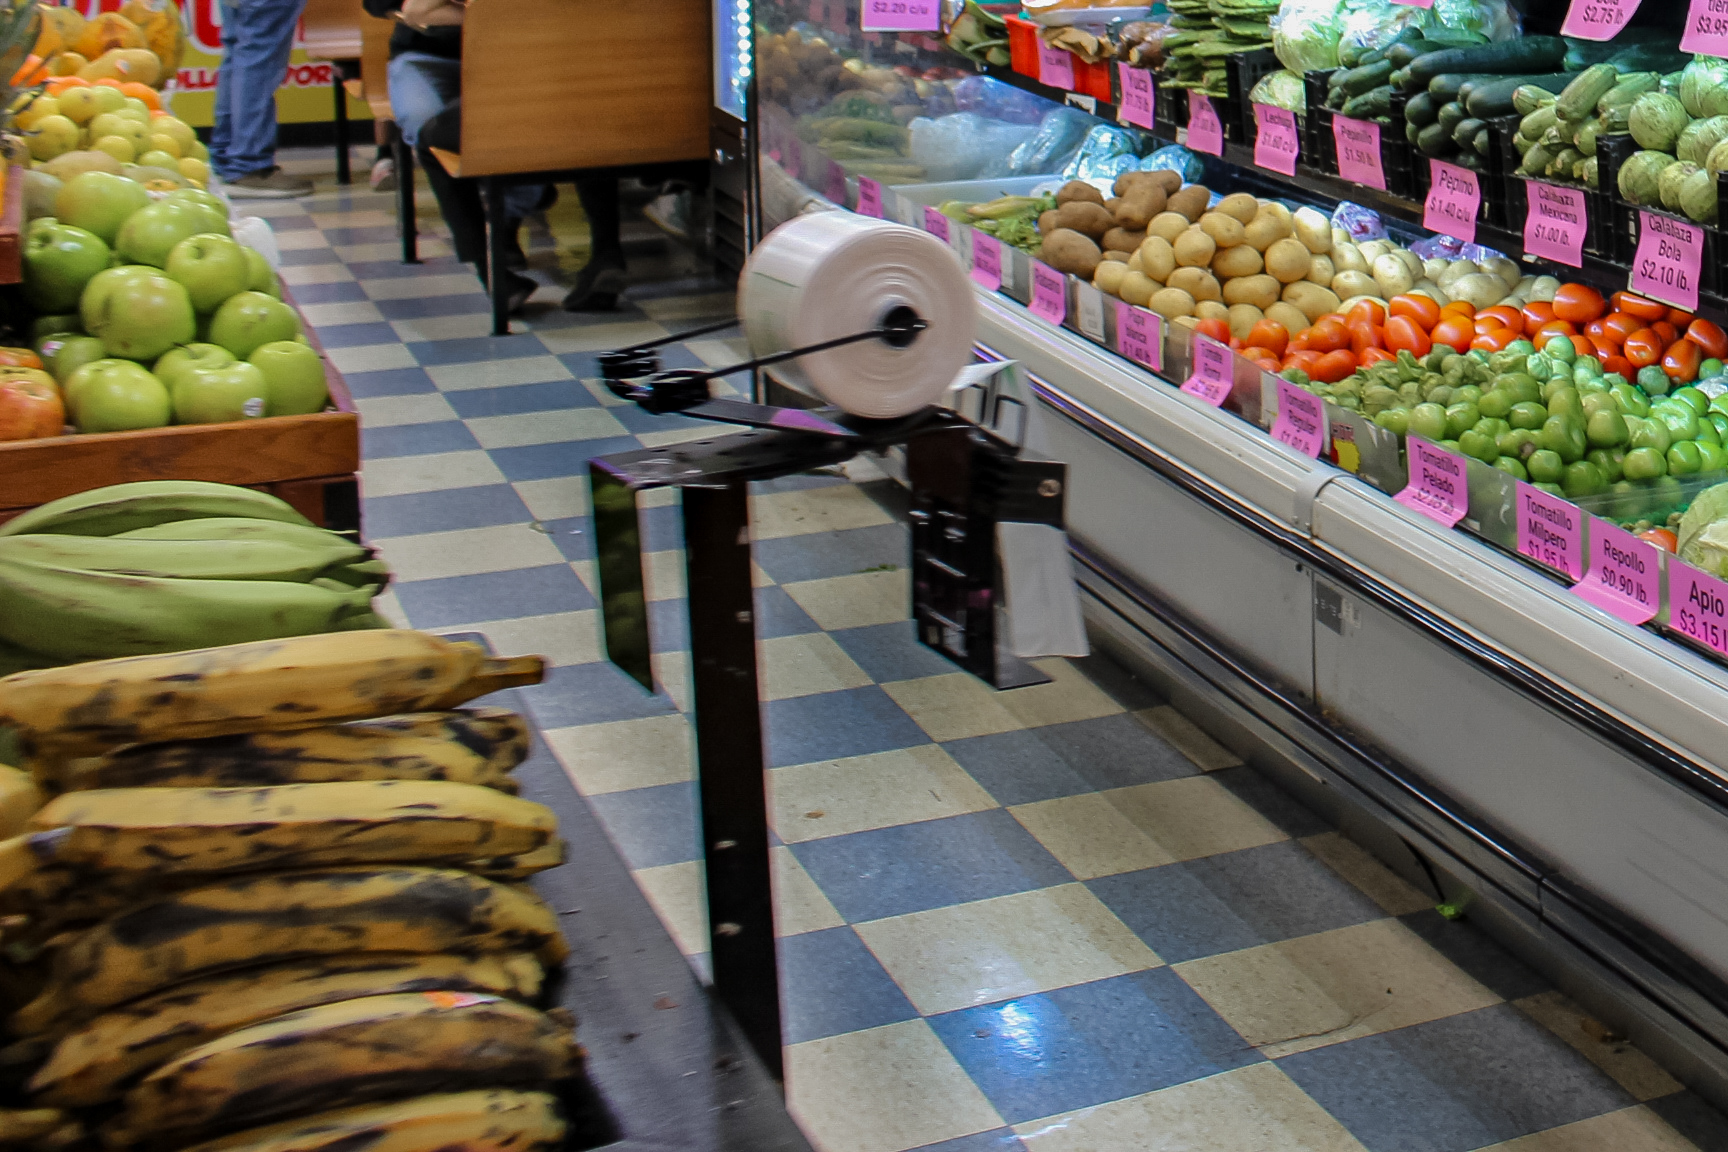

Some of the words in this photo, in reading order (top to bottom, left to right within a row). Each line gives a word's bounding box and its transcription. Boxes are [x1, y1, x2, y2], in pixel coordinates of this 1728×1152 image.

[873, 1, 907, 15] $2.20
[1582, 5, 1614, 25] $2.75
[1438, 168, 1474, 196] Pepino
[1659, 239, 1682, 263] Bola
[1640, 261, 1674, 288] $2.10
[1416, 444, 1461, 478] Tomatillo
[1422, 466, 1455, 496] Pelado
[1524, 494, 1573, 532] Tomatillo
[1527, 518, 1568, 552] Milpero
[1527, 539, 1558, 568] $195
[1603, 538, 1646, 575] Repollo
[1600, 565, 1633, 598] $0.90
[1688, 579, 1726, 618] Apio
[1679, 608, 1719, 648] $3.15
